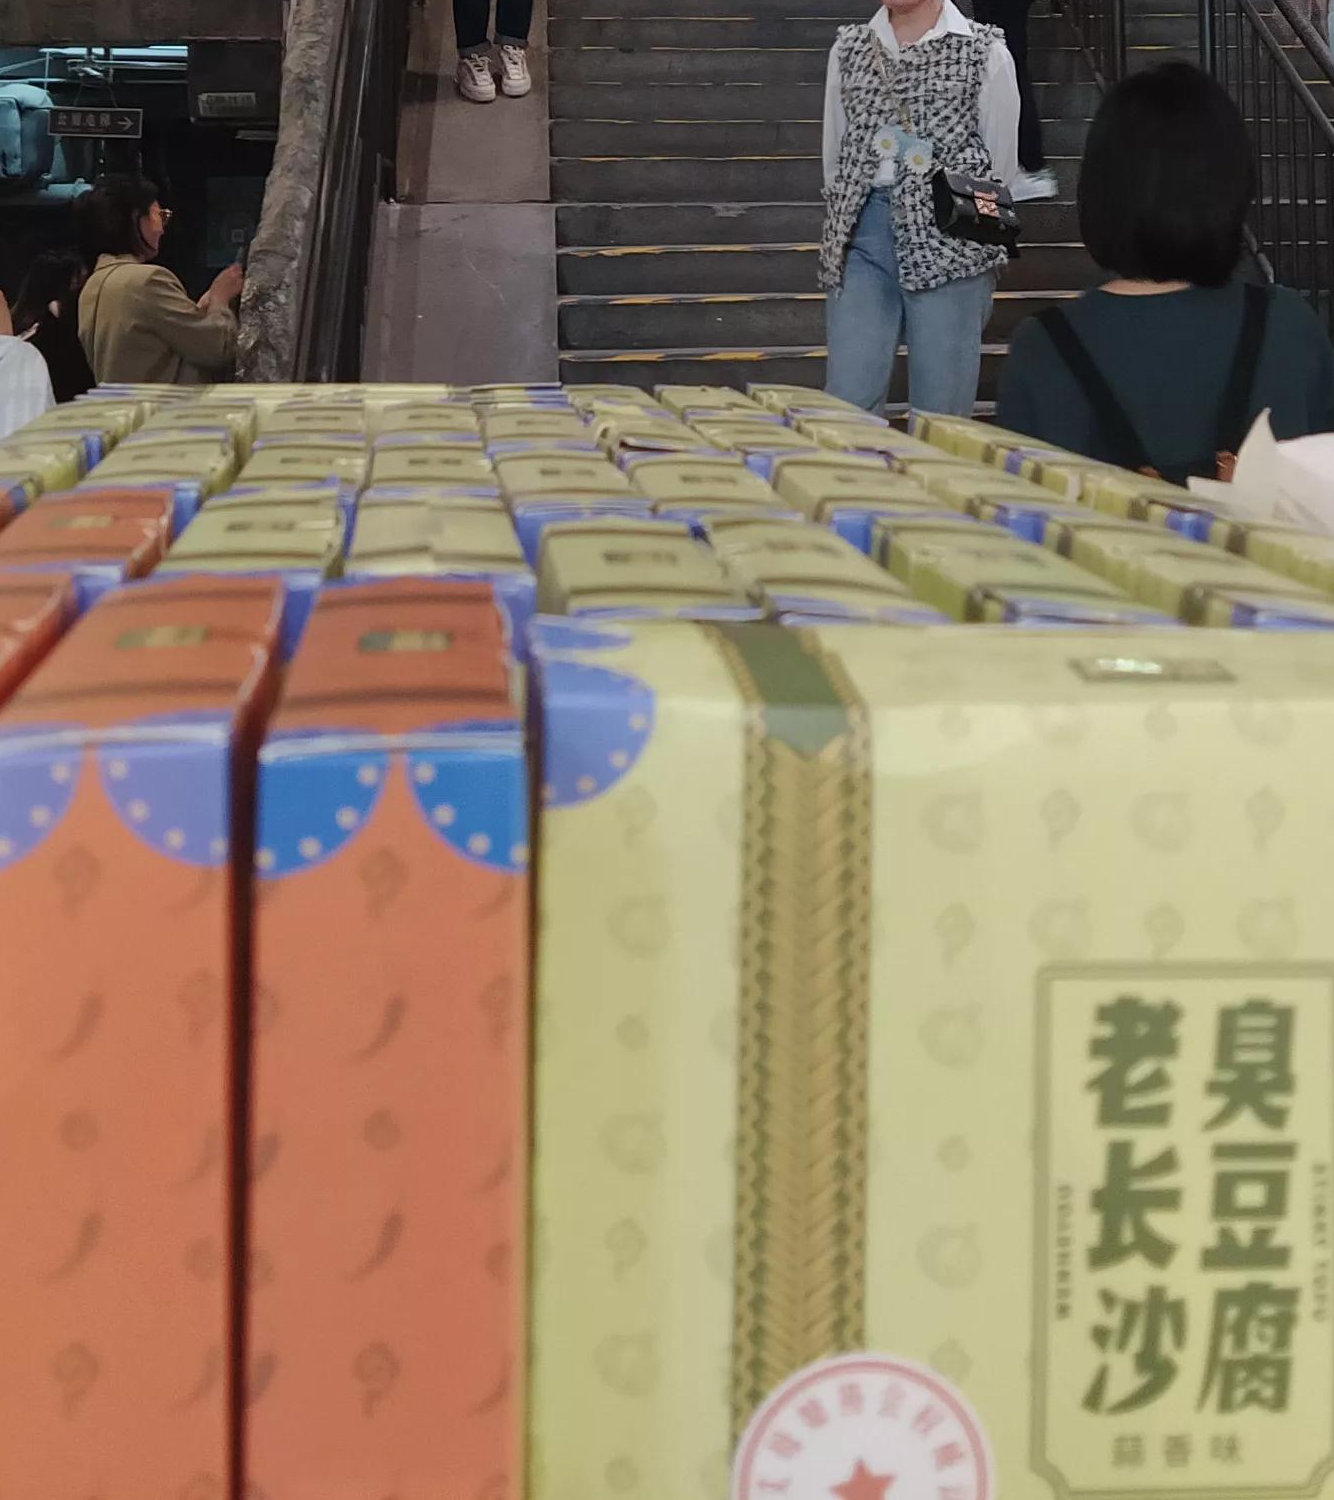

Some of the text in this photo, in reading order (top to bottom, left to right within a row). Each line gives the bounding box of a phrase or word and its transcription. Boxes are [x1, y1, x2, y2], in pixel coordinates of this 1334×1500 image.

[1080, 992, 1188, 1417] 老长沙
[1195, 994, 1302, 1417] 臭豆腐
